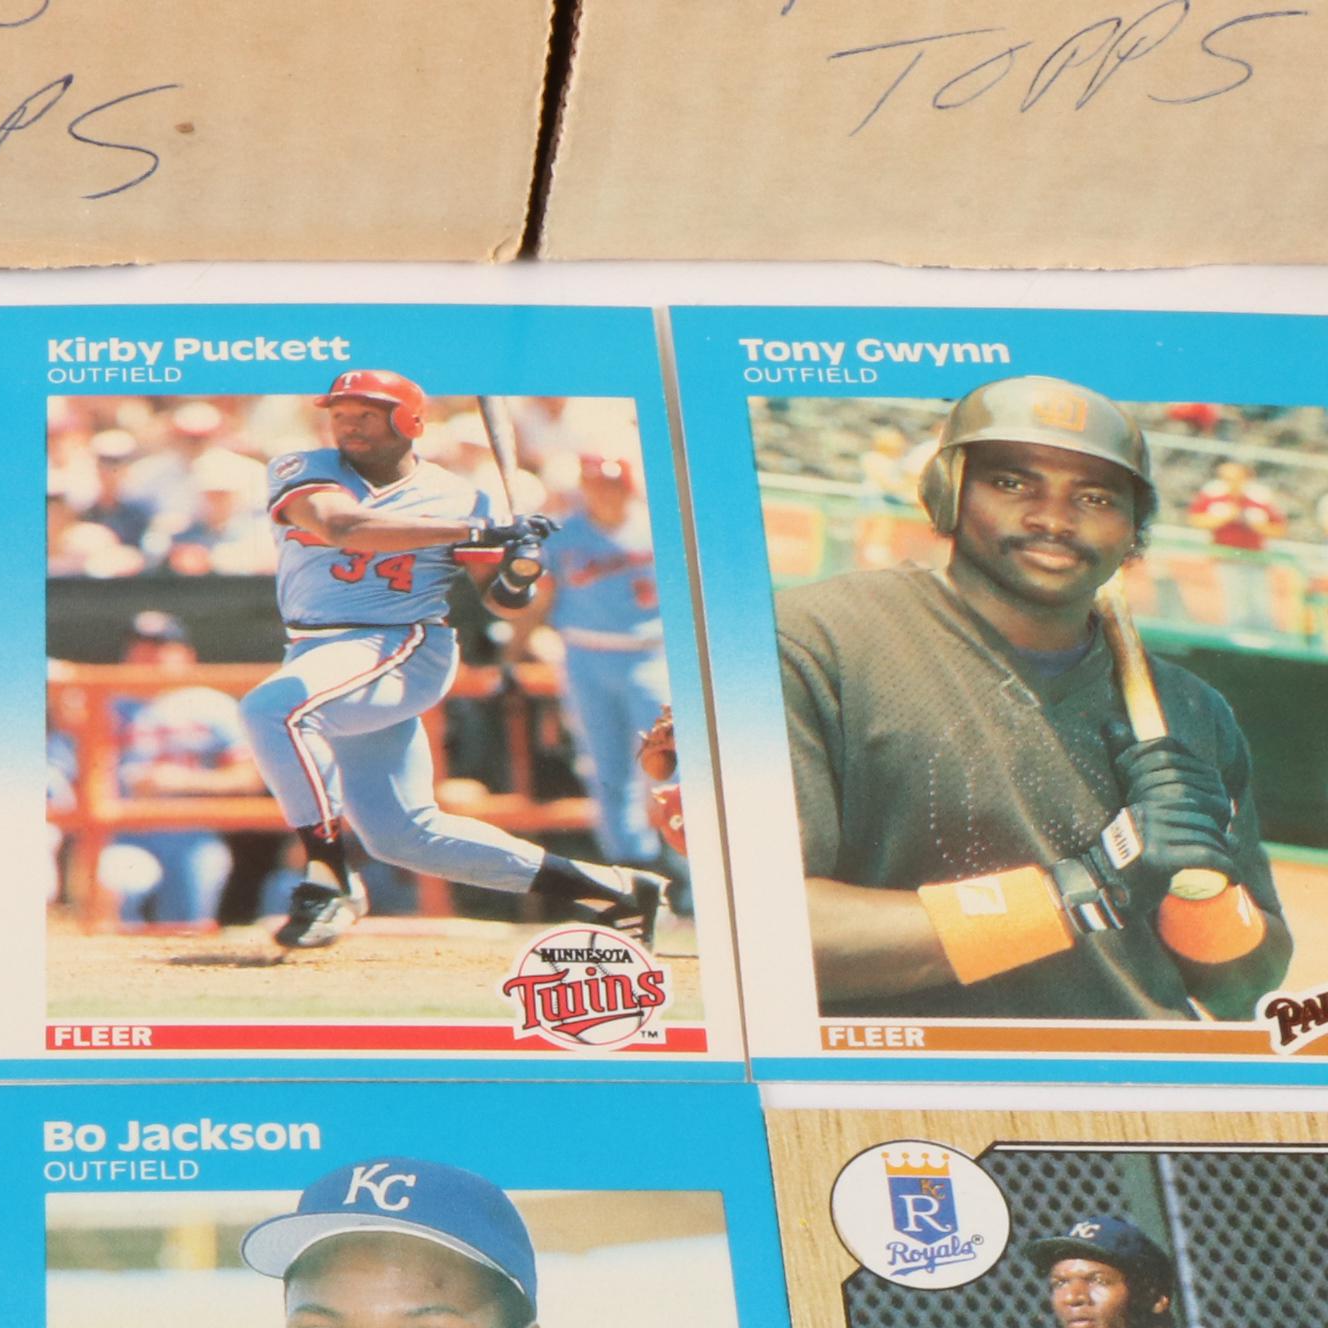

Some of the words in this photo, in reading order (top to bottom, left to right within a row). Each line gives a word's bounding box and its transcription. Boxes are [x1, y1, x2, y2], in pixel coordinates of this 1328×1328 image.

[827, 0, 1309, 137] TOPPS
[48, 337, 162, 365] Kirby
[175, 336, 351, 362] Puckett
[739, 339, 845, 366] Tony
[857, 339, 1011, 366] Gwynn
[47, 366, 183, 384] OUTFIELD
[743, 366, 879, 385] OUTFIELD
[330, 549, 417, 593] 34
[540, 947, 634, 963] MINNESOTA
[503, 966, 666, 1030] Twins
[54, 1026, 152, 1047] FLEER
[828, 1026, 925, 1048] FLEER
[44, 1122, 106, 1152] Bo
[118, 1119, 322, 1152] Jackson
[44, 1159, 200, 1181] OUTFIELD
[342, 1163, 416, 1212] KC
[898, 1194, 952, 1232] R
